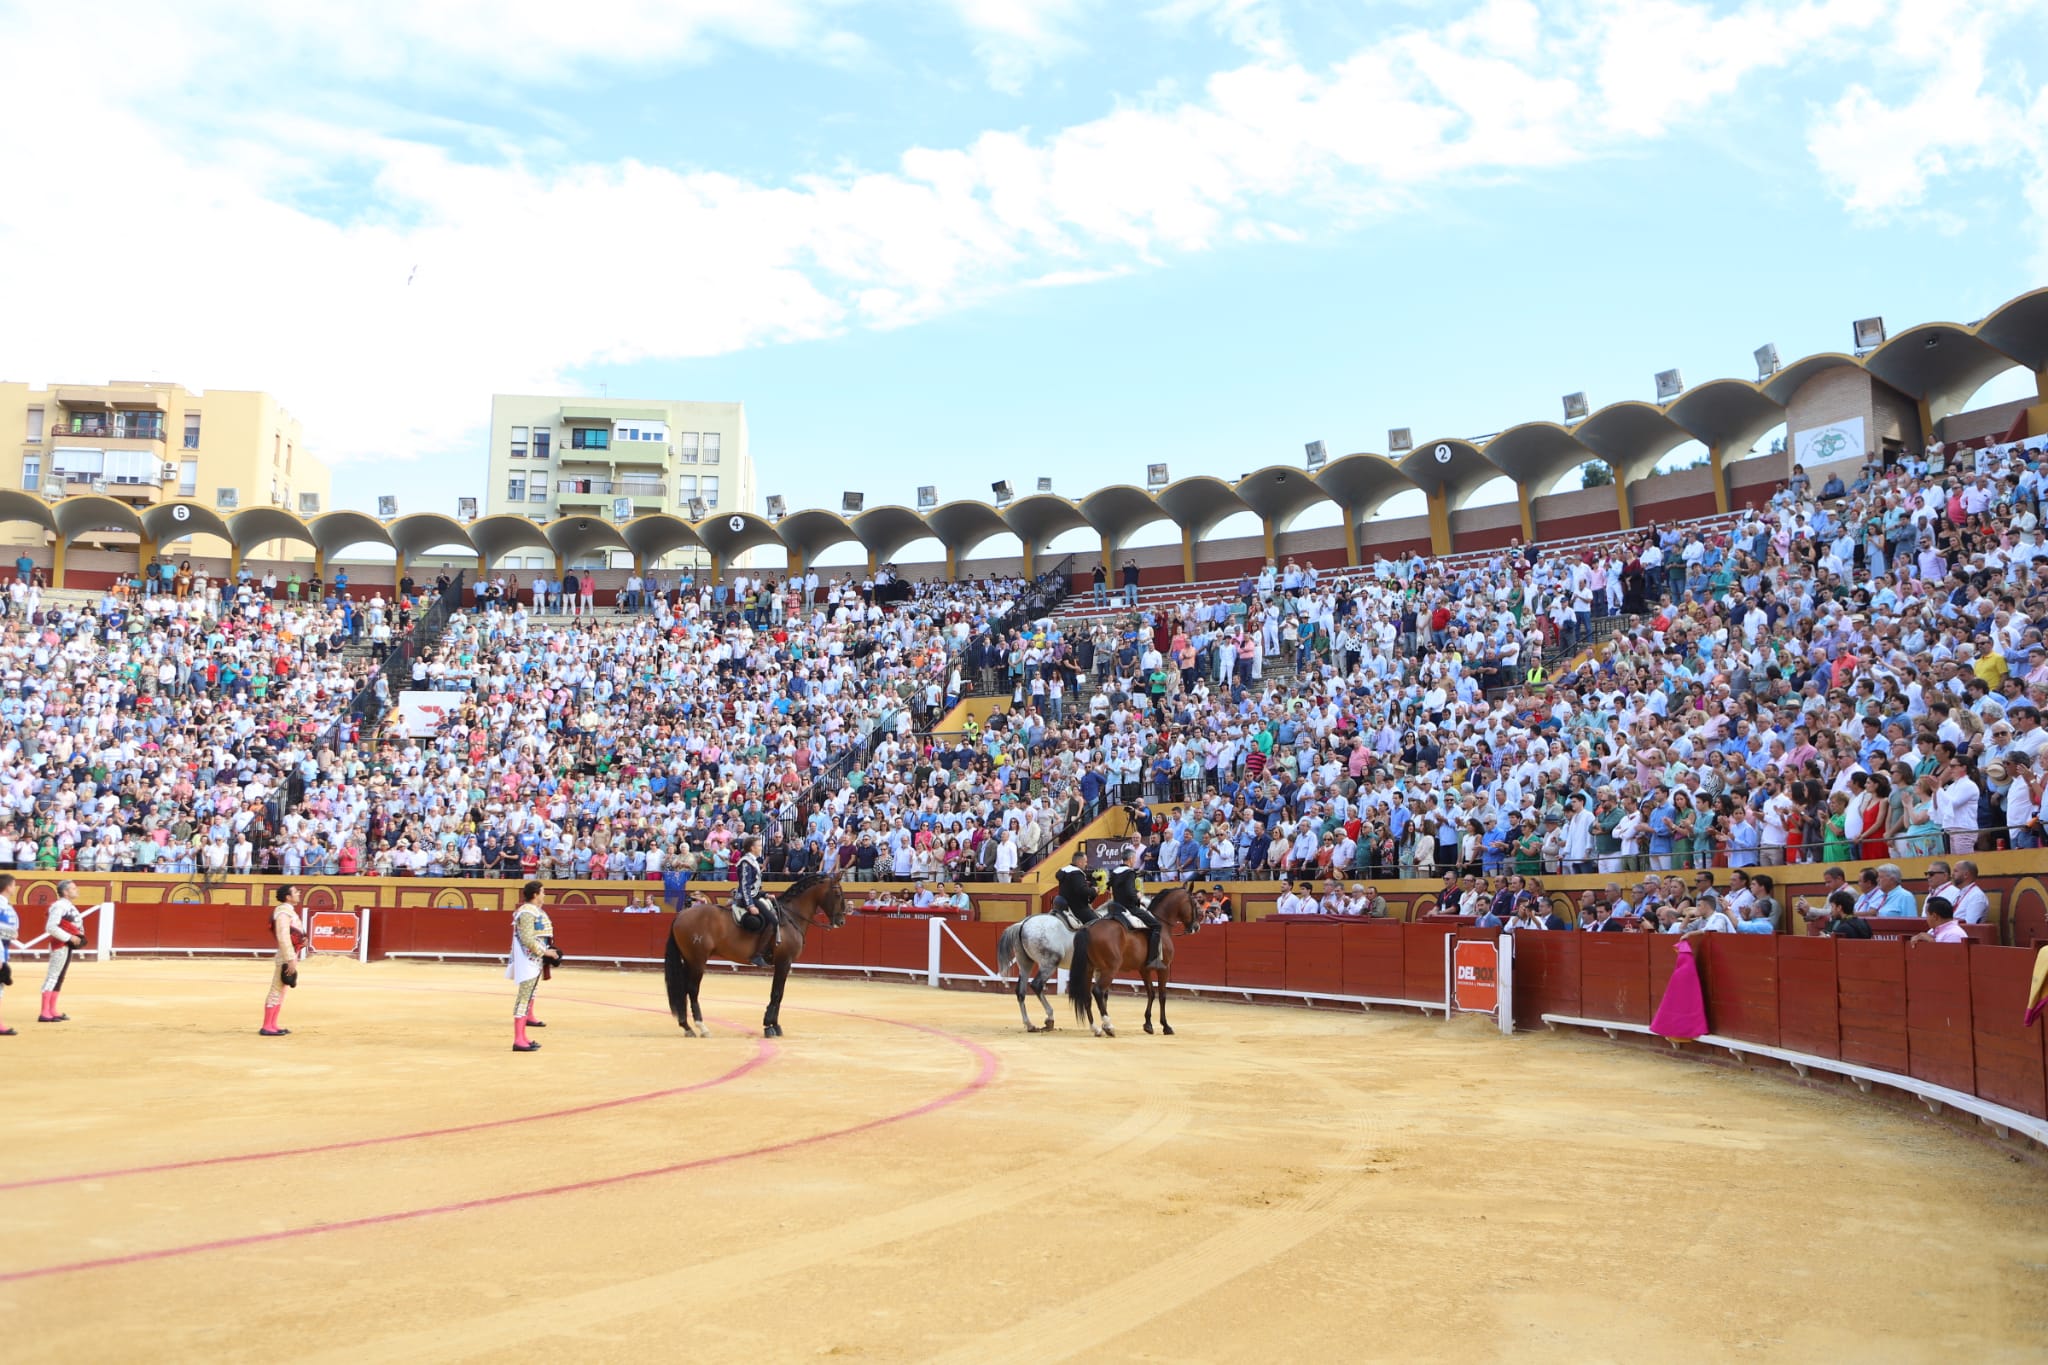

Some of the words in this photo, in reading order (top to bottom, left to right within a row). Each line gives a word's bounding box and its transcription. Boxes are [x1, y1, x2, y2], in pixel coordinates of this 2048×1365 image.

[1439, 446, 1448, 460] 2
[177, 507, 185, 518] 6
[732, 517, 741, 529] 4
[1096, 843, 1119, 859] Pepe
[1458, 966, 1495, 981] DELBOX
